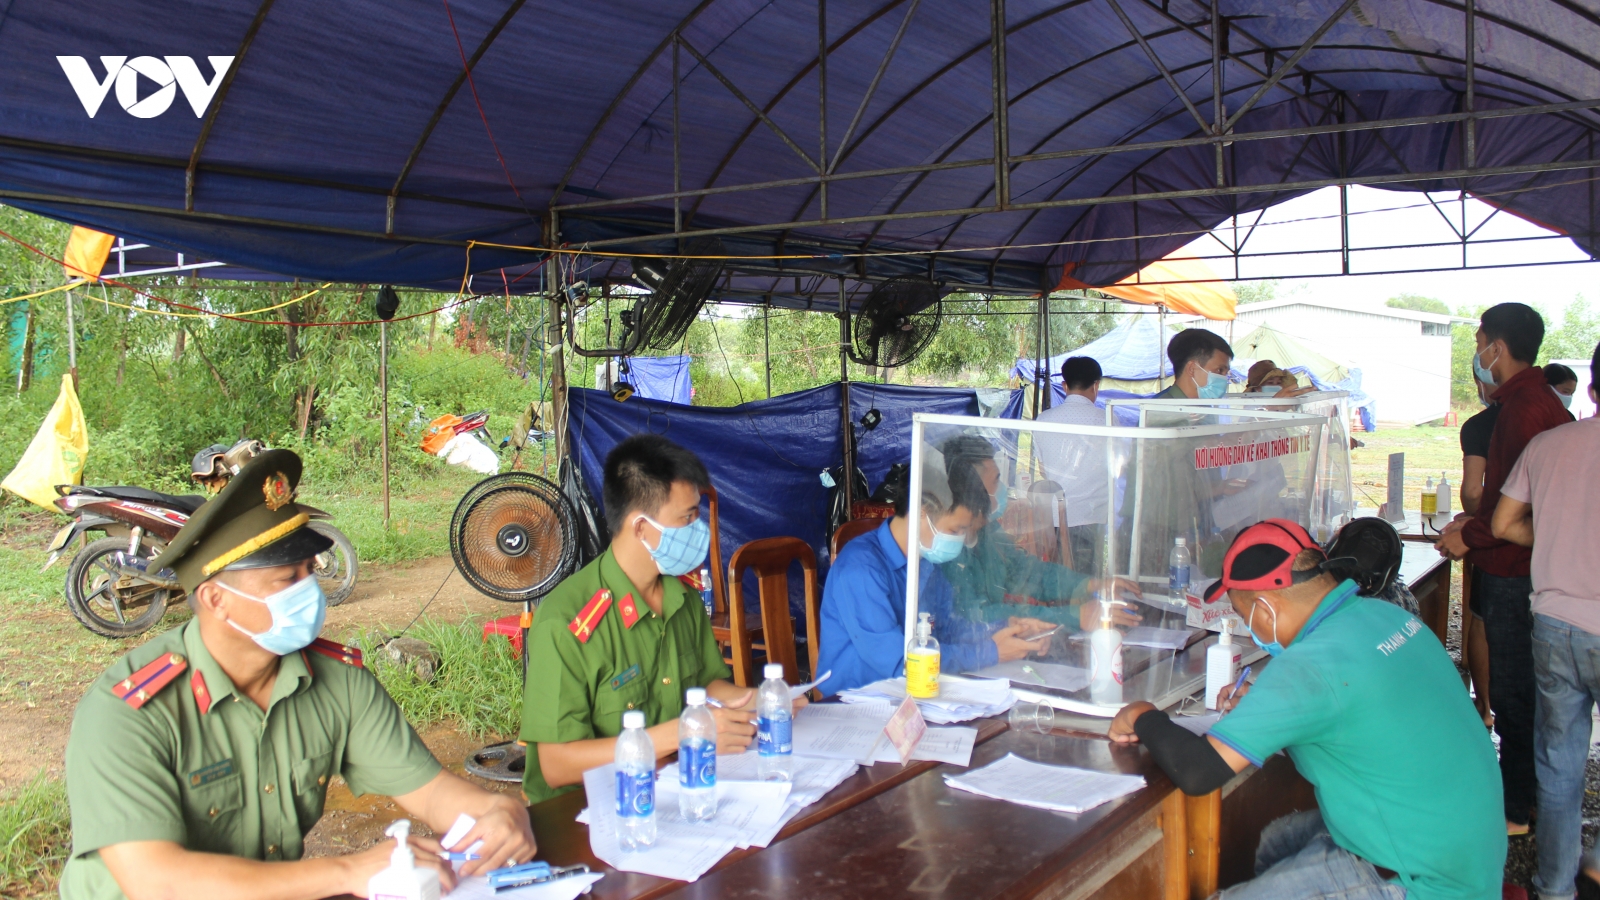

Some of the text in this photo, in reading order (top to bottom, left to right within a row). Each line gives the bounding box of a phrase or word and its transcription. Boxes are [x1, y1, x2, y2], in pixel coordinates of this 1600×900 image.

[1195, 446, 1208, 469] NƠI
[1255, 441, 1270, 461] KHAI
[1271, 435, 1289, 458] THÔNG
